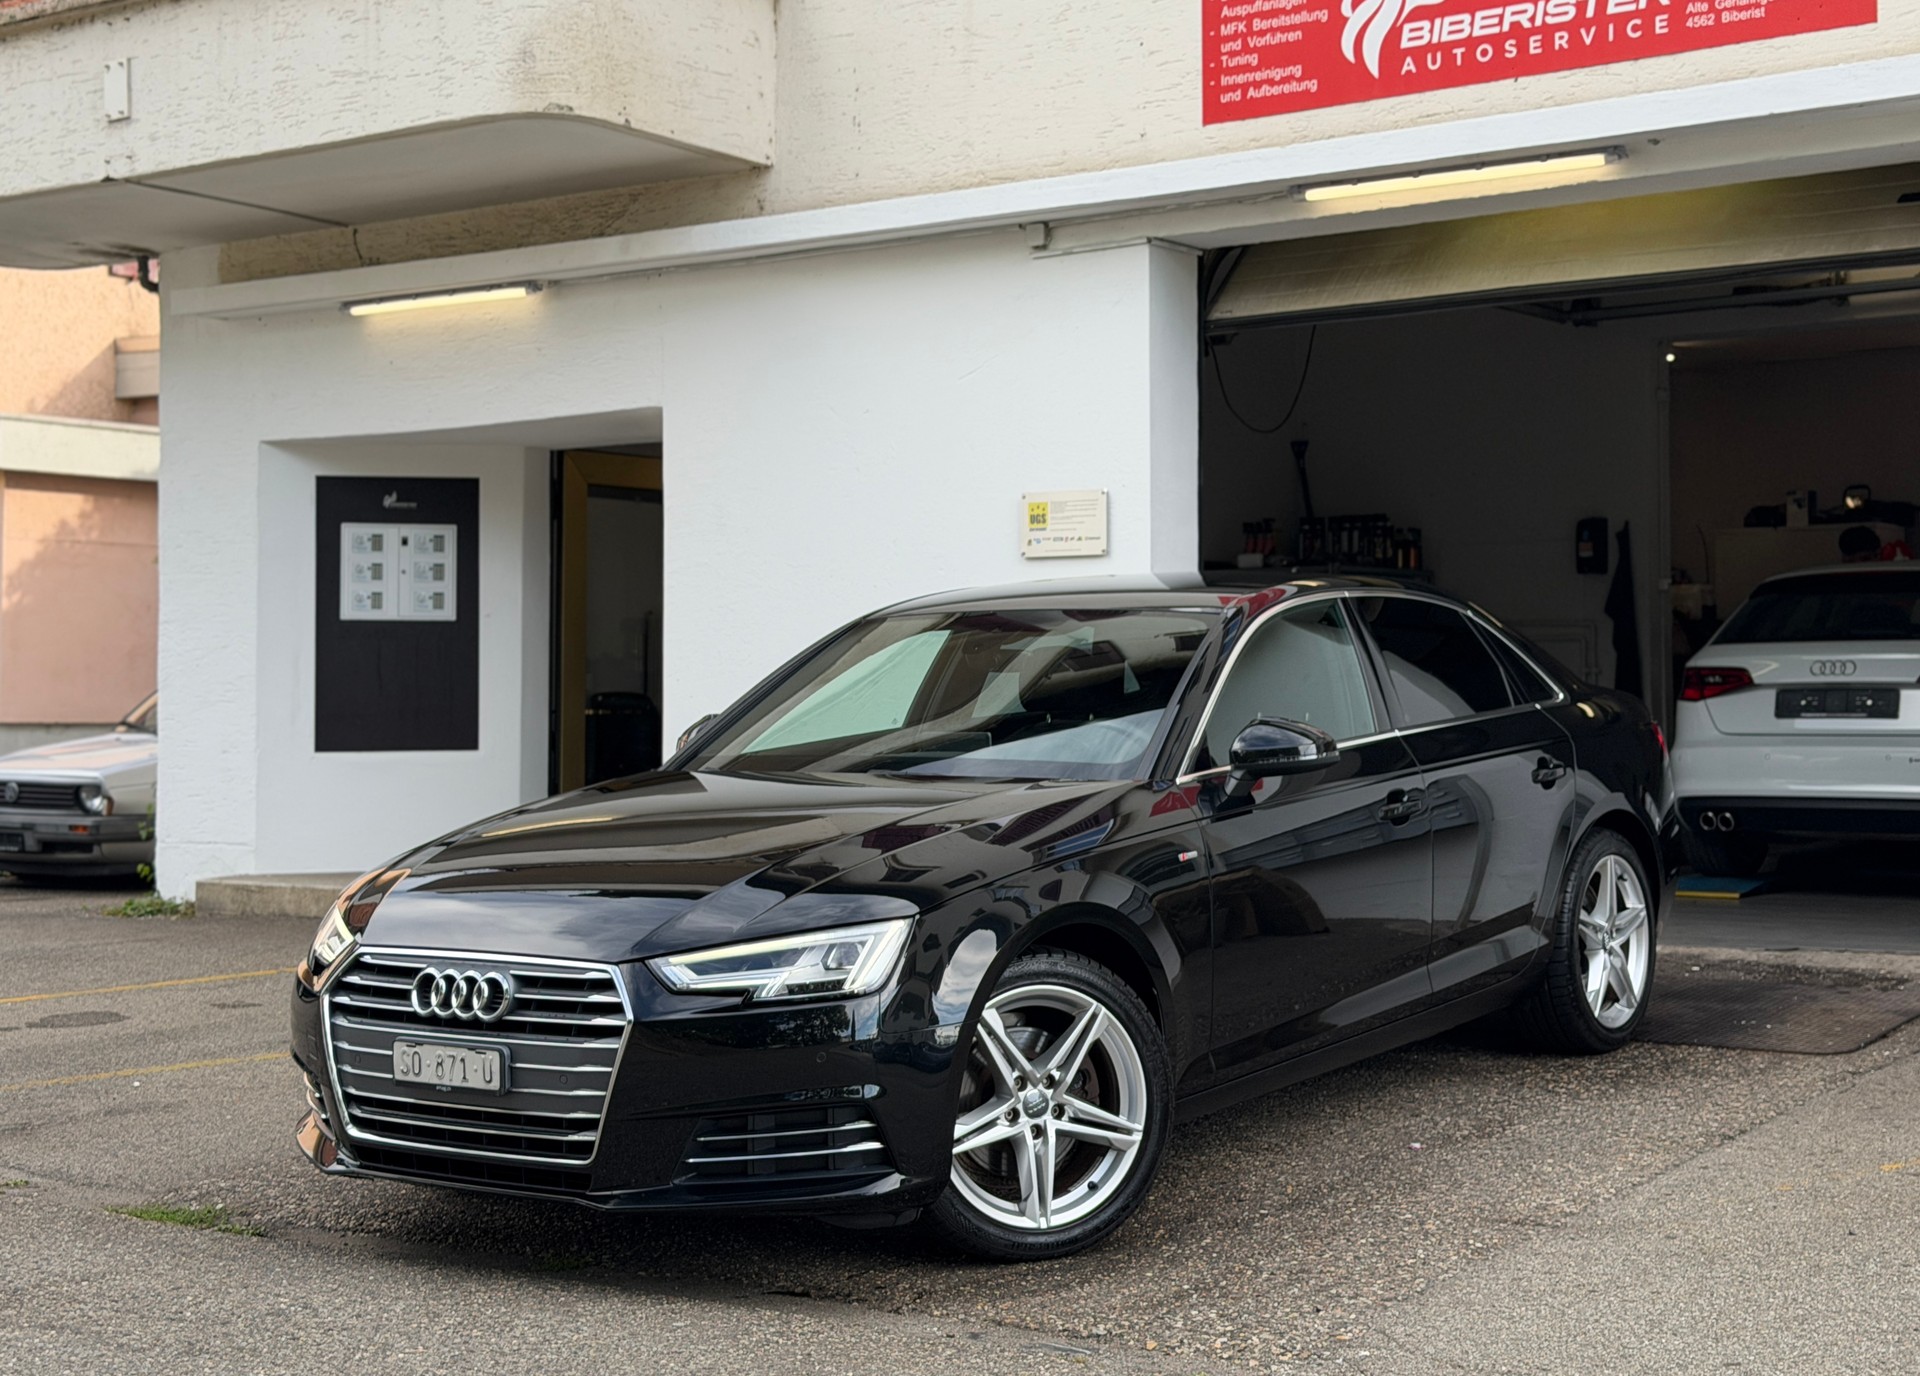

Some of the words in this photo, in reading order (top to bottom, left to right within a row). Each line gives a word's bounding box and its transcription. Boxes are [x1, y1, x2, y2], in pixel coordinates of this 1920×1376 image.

[1685, 2, 1709, 14] Alte
[1685, 13, 1715, 28] 4562
[1721, 6, 1766, 23] Biberist
[1221, 20, 1247, 37] MFK
[1252, 9, 1328, 31] Bereitstellung
[1221, 38, 1242, 53] und
[1401, 14, 1669, 75] AUTOSERVICE
[1221, 53, 1258, 68] Tuning
[1221, 64, 1302, 86] Innenreinigung
[1220, 89, 1241, 103] und
[1247, 79, 1318, 99] Aufbereitung
